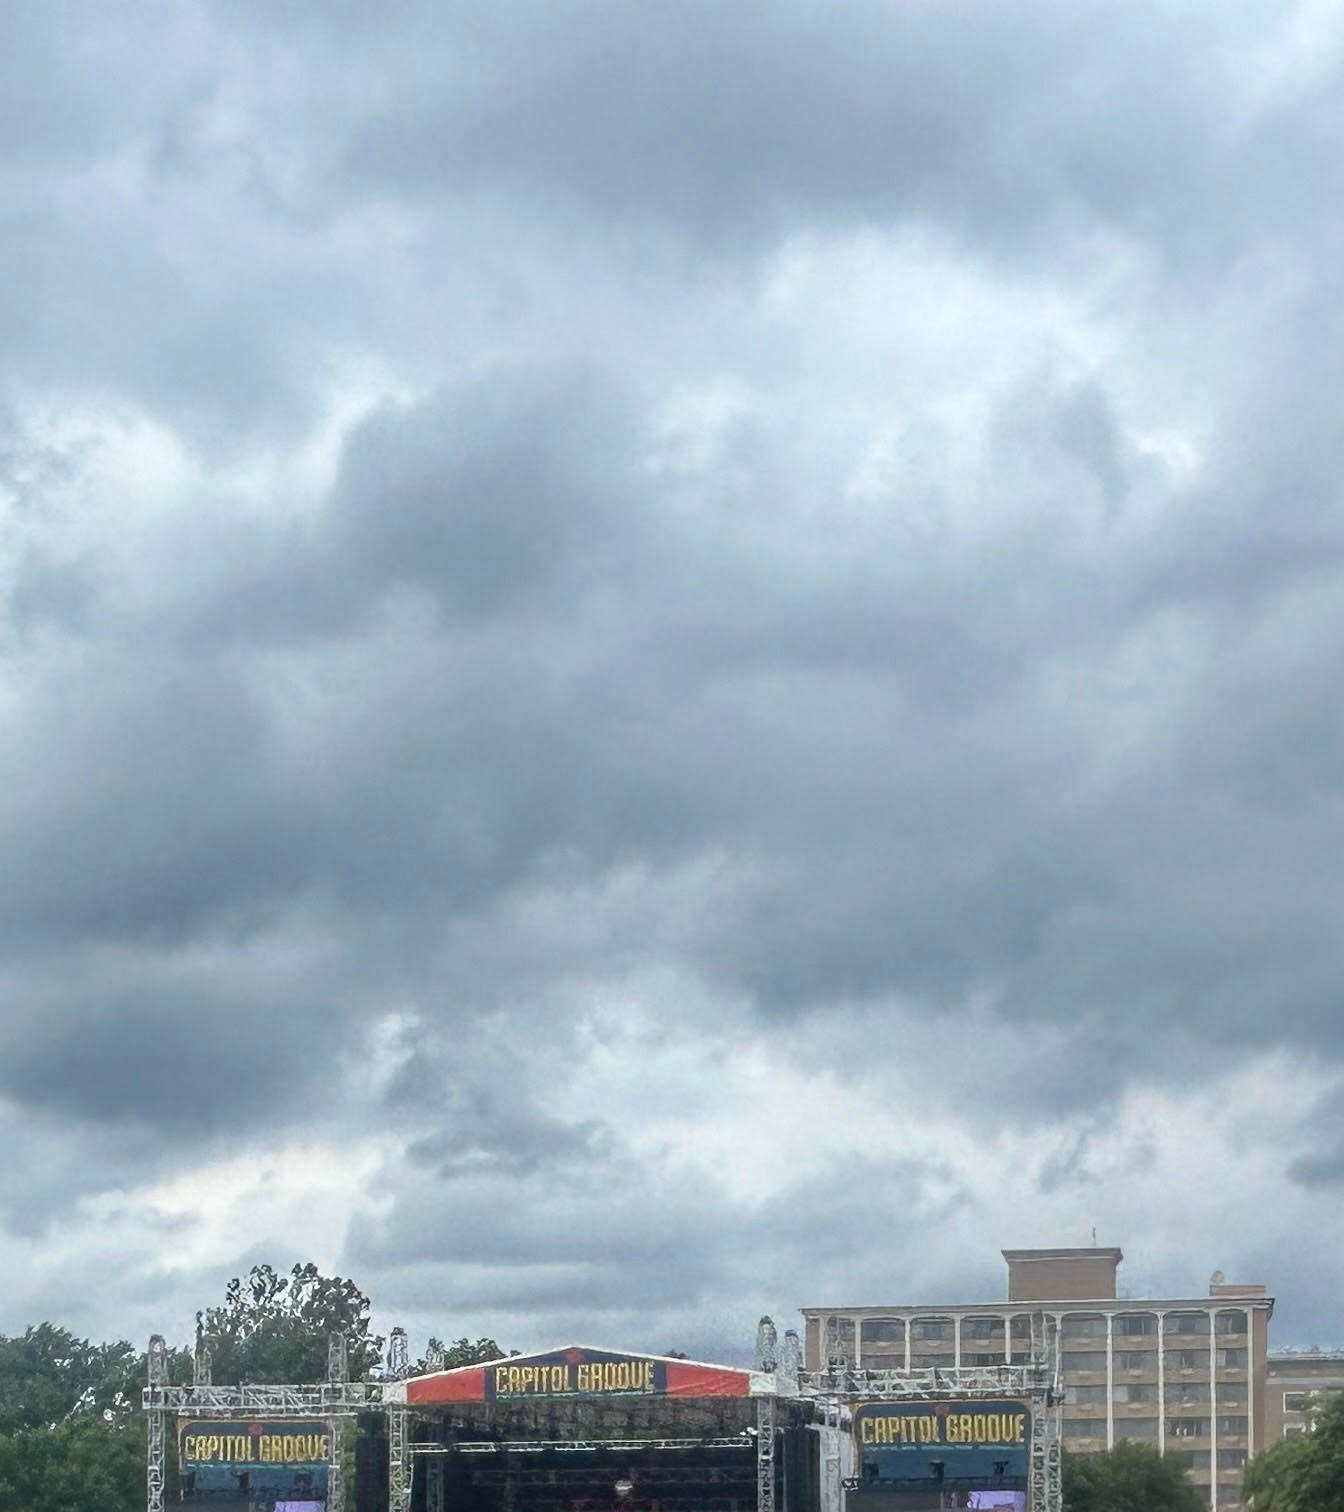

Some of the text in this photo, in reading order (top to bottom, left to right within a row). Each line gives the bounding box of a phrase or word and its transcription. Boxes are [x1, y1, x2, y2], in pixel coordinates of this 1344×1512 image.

[495, 1361, 655, 1393] CAPITOL GROOVE
[861, 1413, 1025, 1444] CAPITOL GROOVE
[184, 1434, 330, 1462] CAPITOL GROOVE
